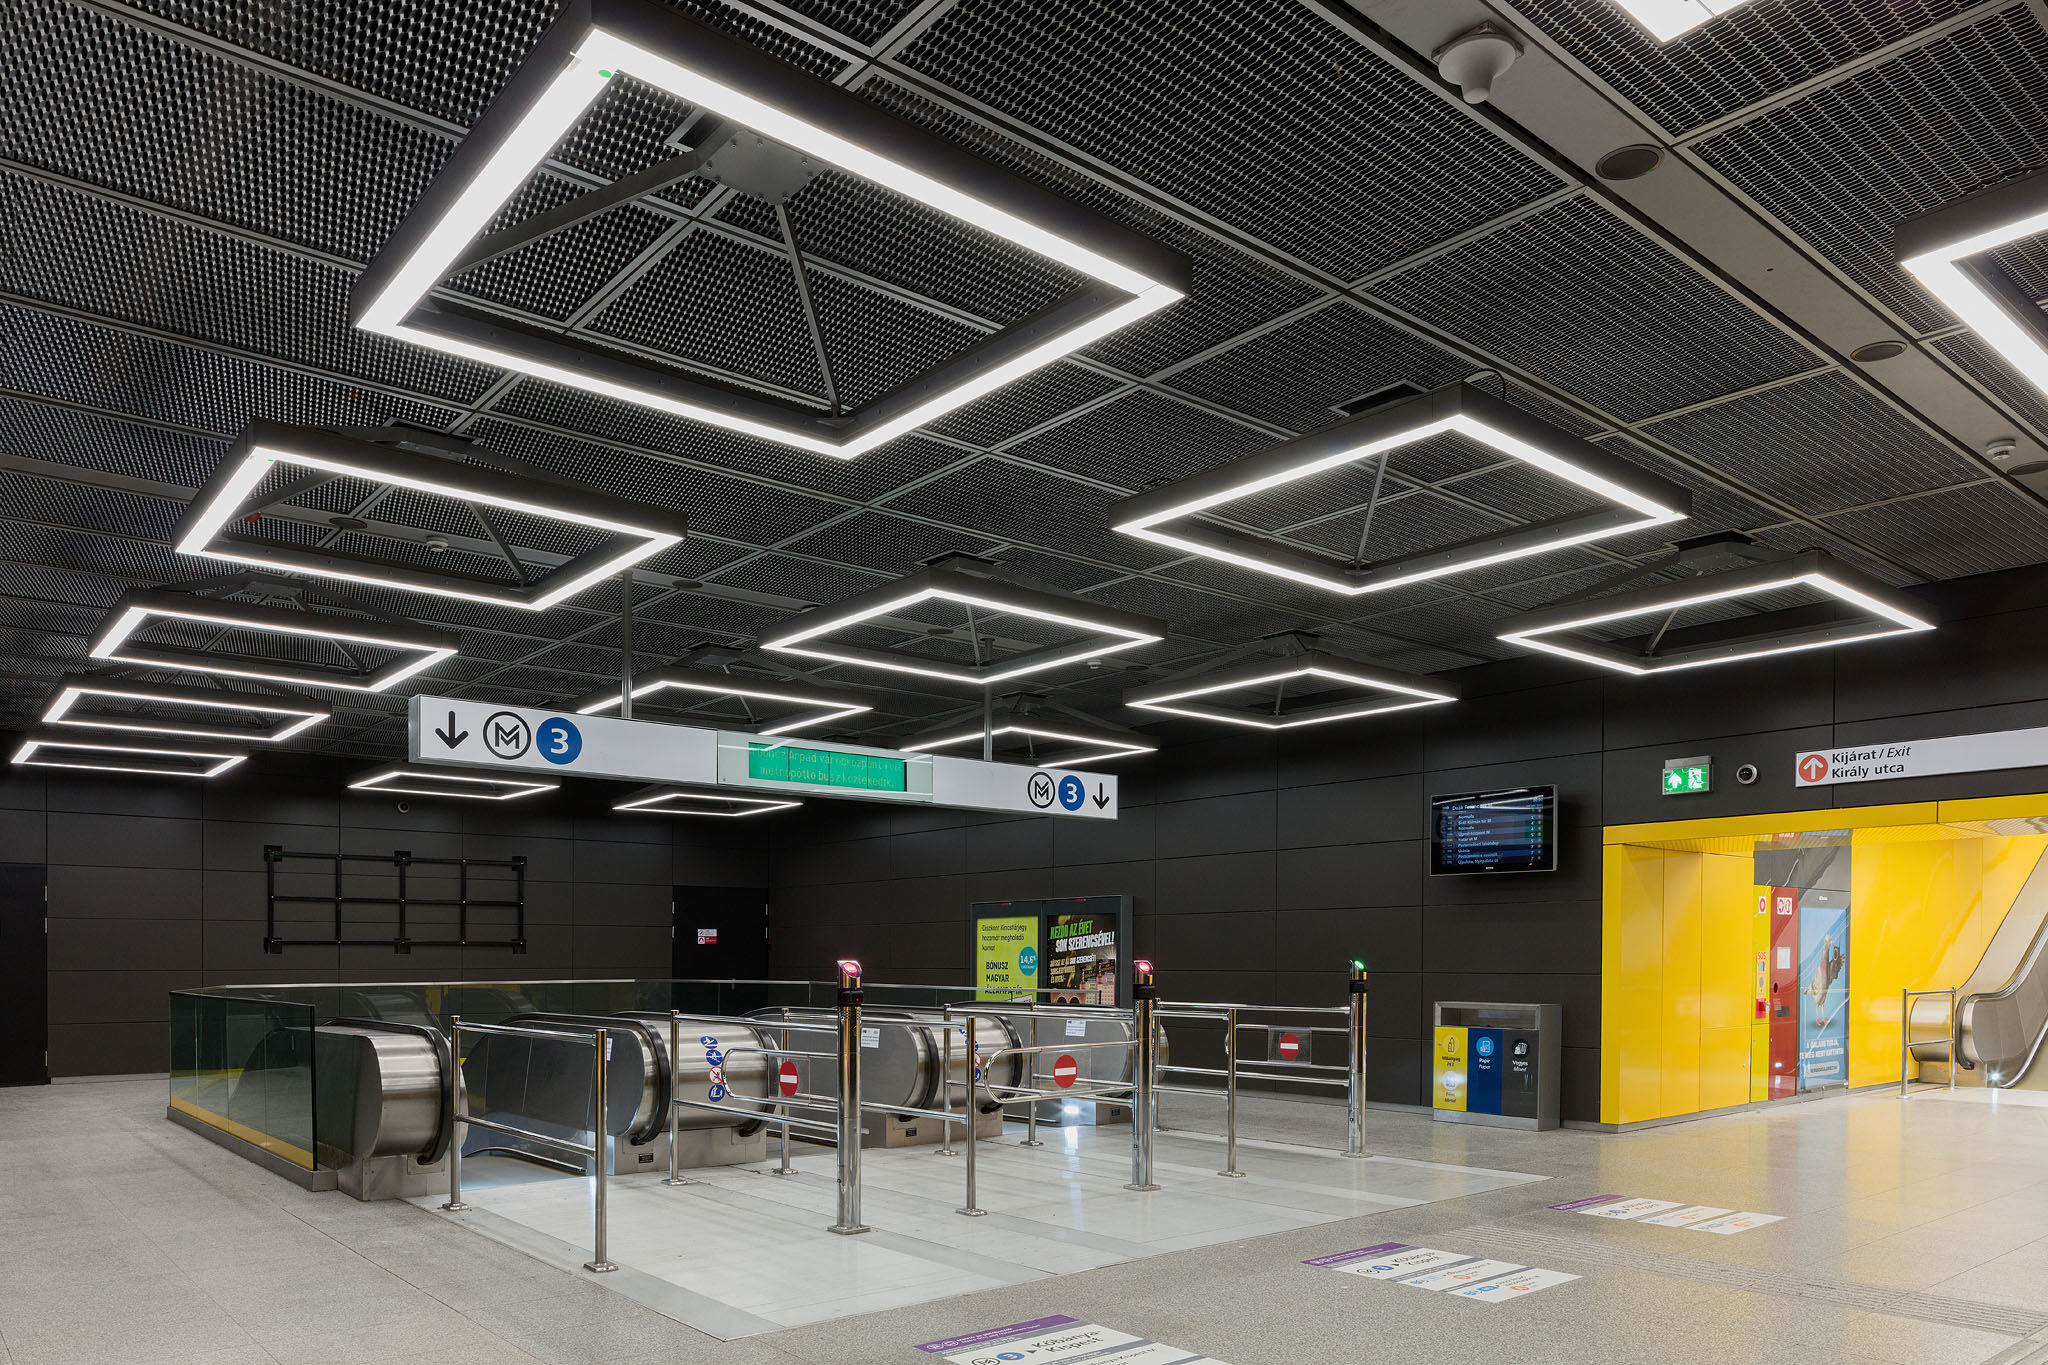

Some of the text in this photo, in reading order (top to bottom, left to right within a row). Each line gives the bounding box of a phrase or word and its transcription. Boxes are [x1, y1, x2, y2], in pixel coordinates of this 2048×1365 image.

[550, 728, 569, 755] 3
[1832, 745, 1911, 765] Kijárat / Exit
[1832, 764, 1904, 779] Király utca
[1066, 783, 1078, 803] 3
[1070, 922, 1078, 937] AZ
[1055, 938, 1068, 953] SOK
[985, 959, 1009, 970] BÓNUSZ
[985, 973, 1010, 983] MAGYAR
